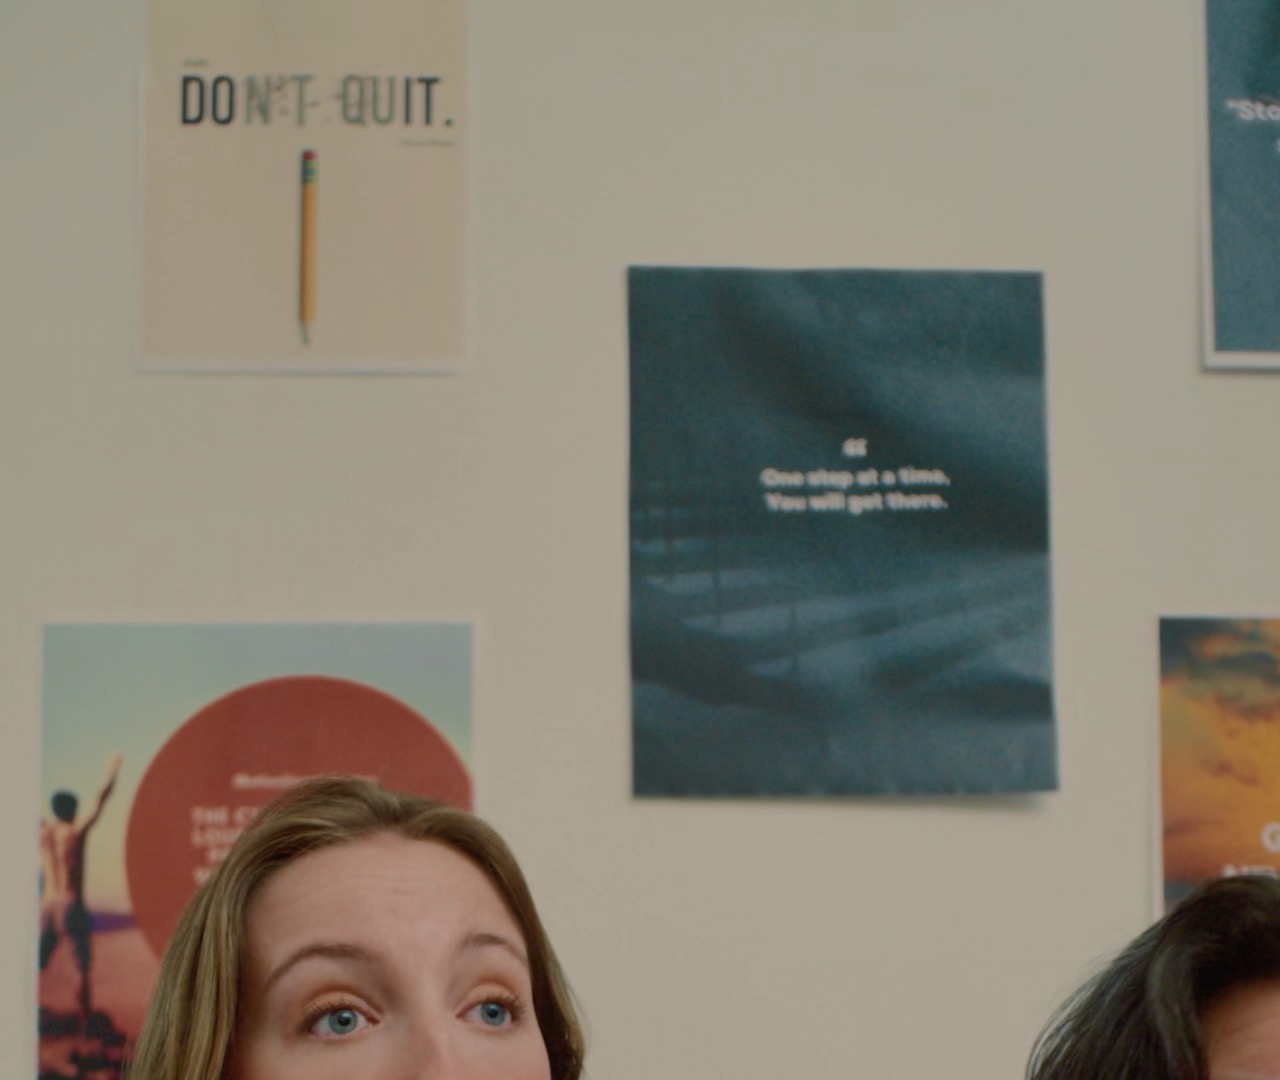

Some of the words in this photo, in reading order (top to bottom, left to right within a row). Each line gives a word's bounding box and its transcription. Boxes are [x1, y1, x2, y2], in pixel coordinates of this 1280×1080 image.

[180, 74, 316, 127] DON'T
[340, 74, 455, 127] QUIT.
[759, 467, 804, 487] One
[806, 467, 854, 490] step
[856, 467, 879, 486] at
[881, 470, 896, 486] a
[764, 492, 806, 511] You
[808, 491, 846, 511] will
[847, 492, 883, 516] get
